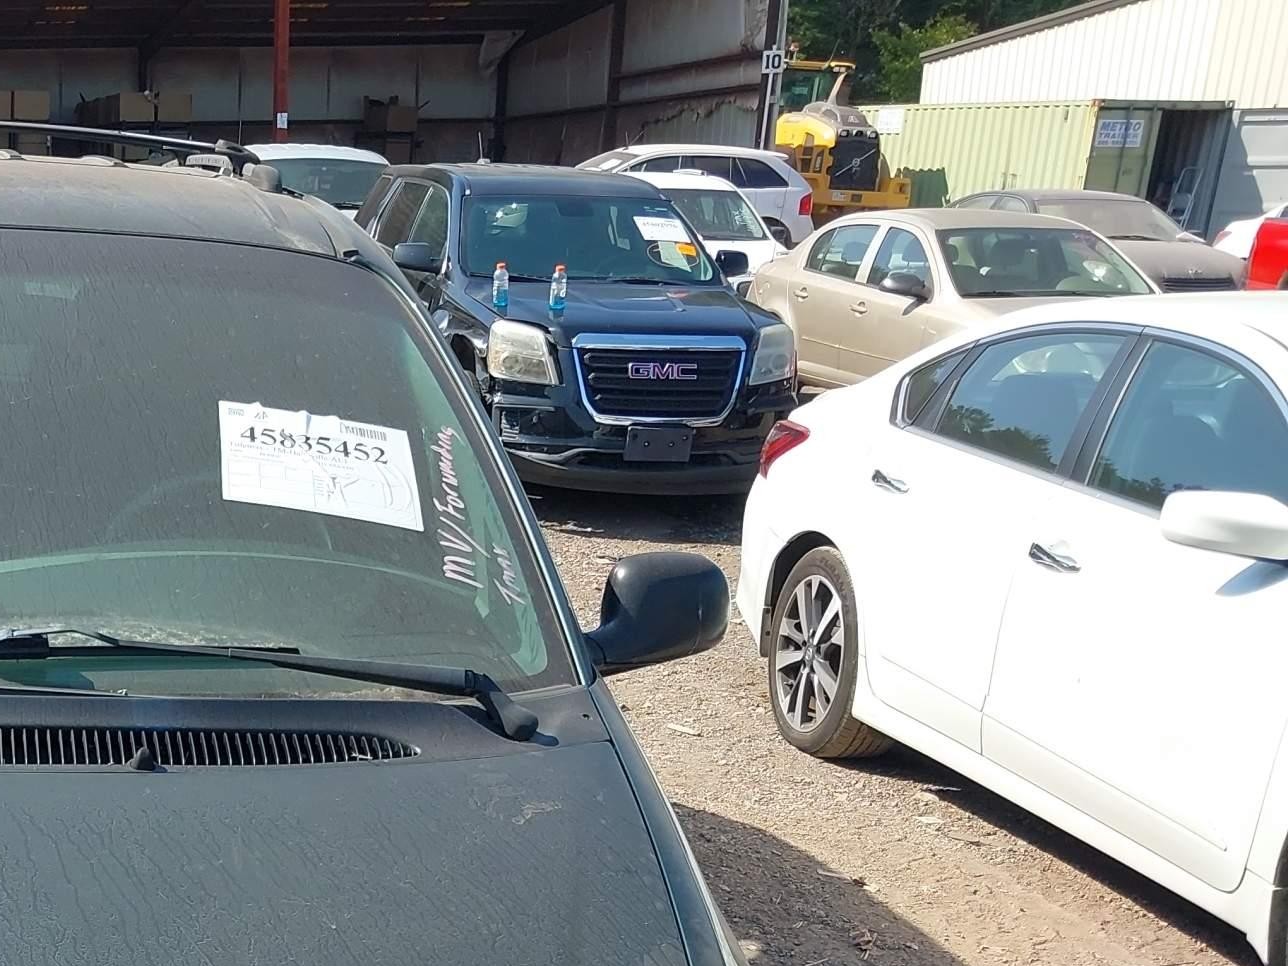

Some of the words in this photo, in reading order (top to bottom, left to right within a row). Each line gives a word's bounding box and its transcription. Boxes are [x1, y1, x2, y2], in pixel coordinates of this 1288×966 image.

[765, 54, 782, 70] 10
[628, 362, 698, 380] GMC
[240, 425, 389, 465] 45835452
